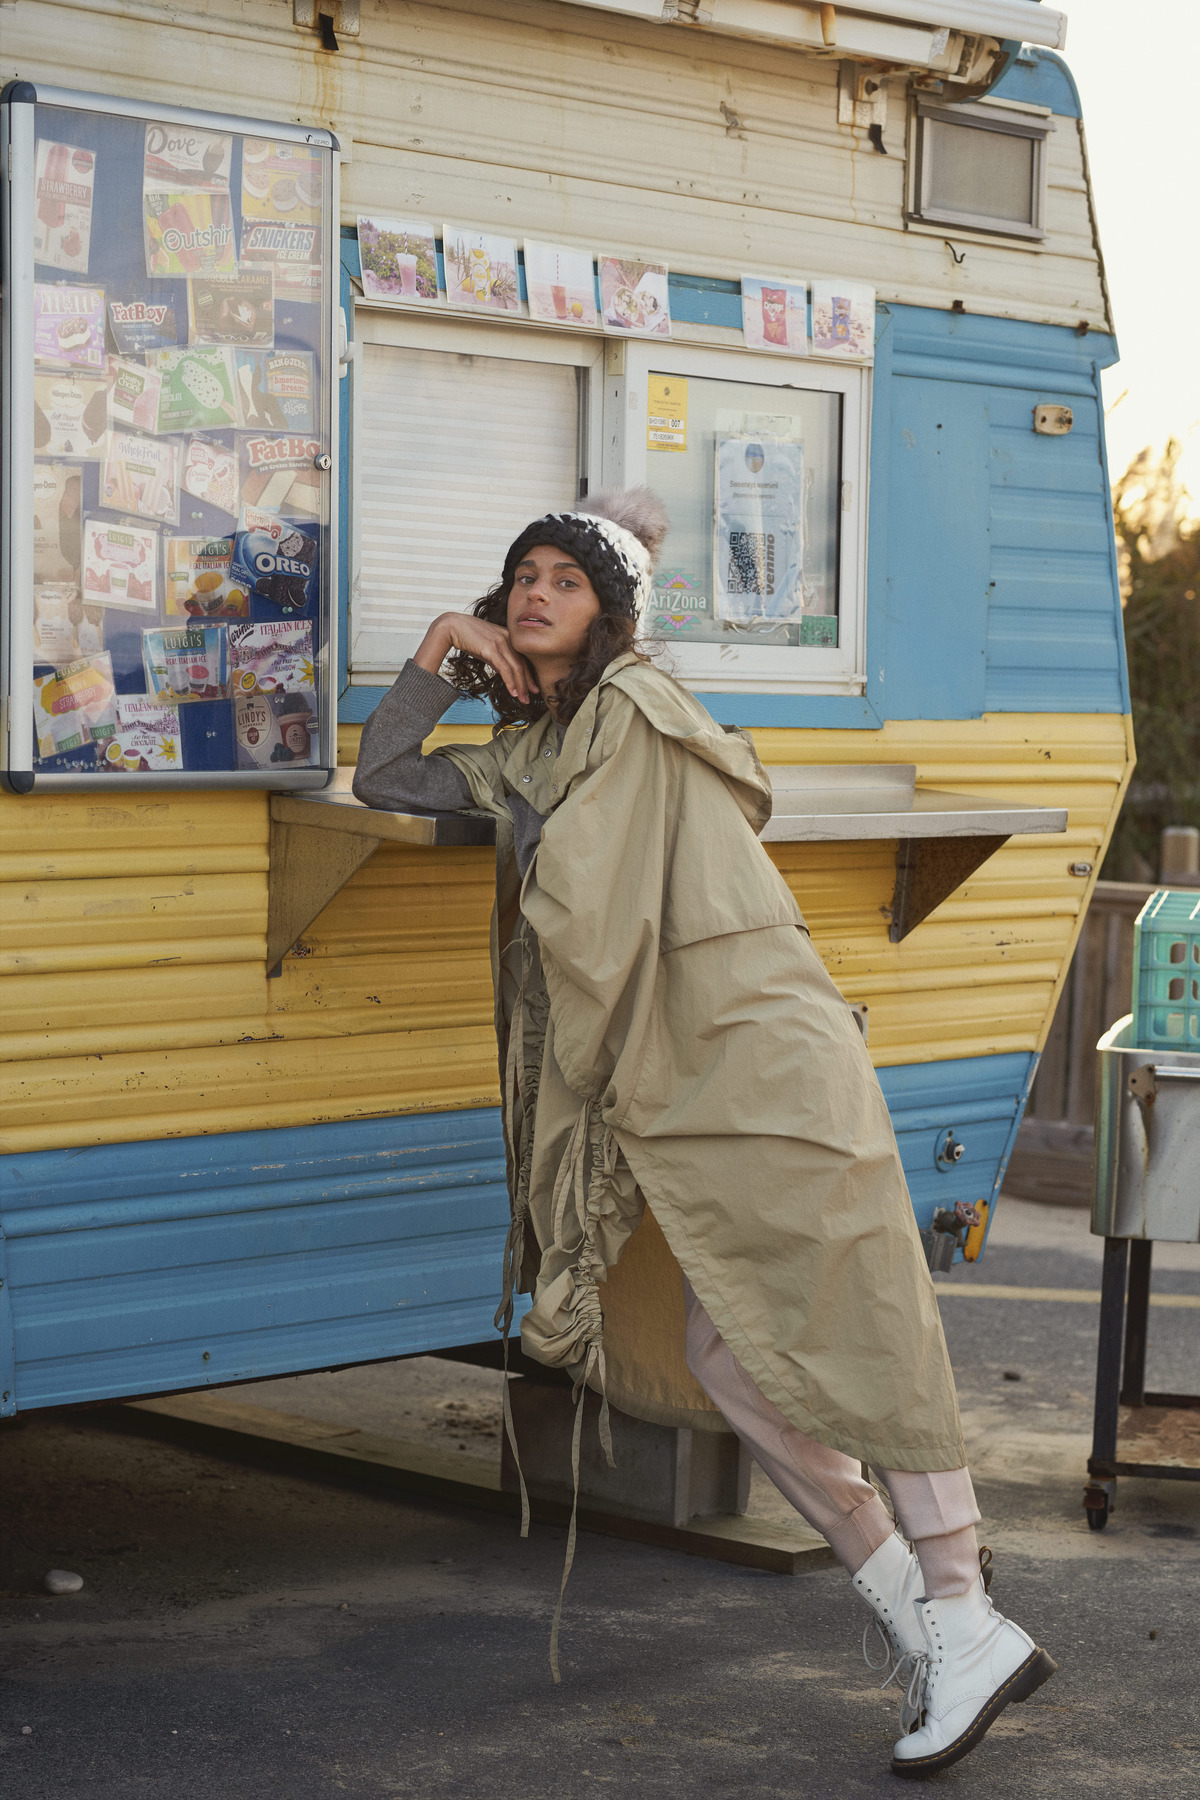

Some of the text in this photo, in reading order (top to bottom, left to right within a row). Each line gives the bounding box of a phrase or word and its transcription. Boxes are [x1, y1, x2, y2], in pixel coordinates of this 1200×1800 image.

[147, 126, 198, 156] Dove
[40, 178, 87, 198] STRAWBERRY
[250, 228, 314, 250] SNICKERS
[277, 250, 310, 260] ICE CREAM
[235, 274, 270, 284] CARAMEL
[111, 302, 166, 324] FatBoy
[764, 301, 784, 311] Doritos
[118, 377, 140, 392] Choice
[671, 420, 680, 428] 007
[191, 544, 226, 555] LUIGI'S
[256, 554, 310, 577] OREO
[767, 534, 775, 595] venmo
[646, 589, 706, 612] AriZona
[260, 622, 292, 636] ITALIAN
[165, 634, 202, 649] LUIGI'S
[59, 687, 97, 710] STRAWBERRY
[124, 702, 151, 712] ITALIAN
